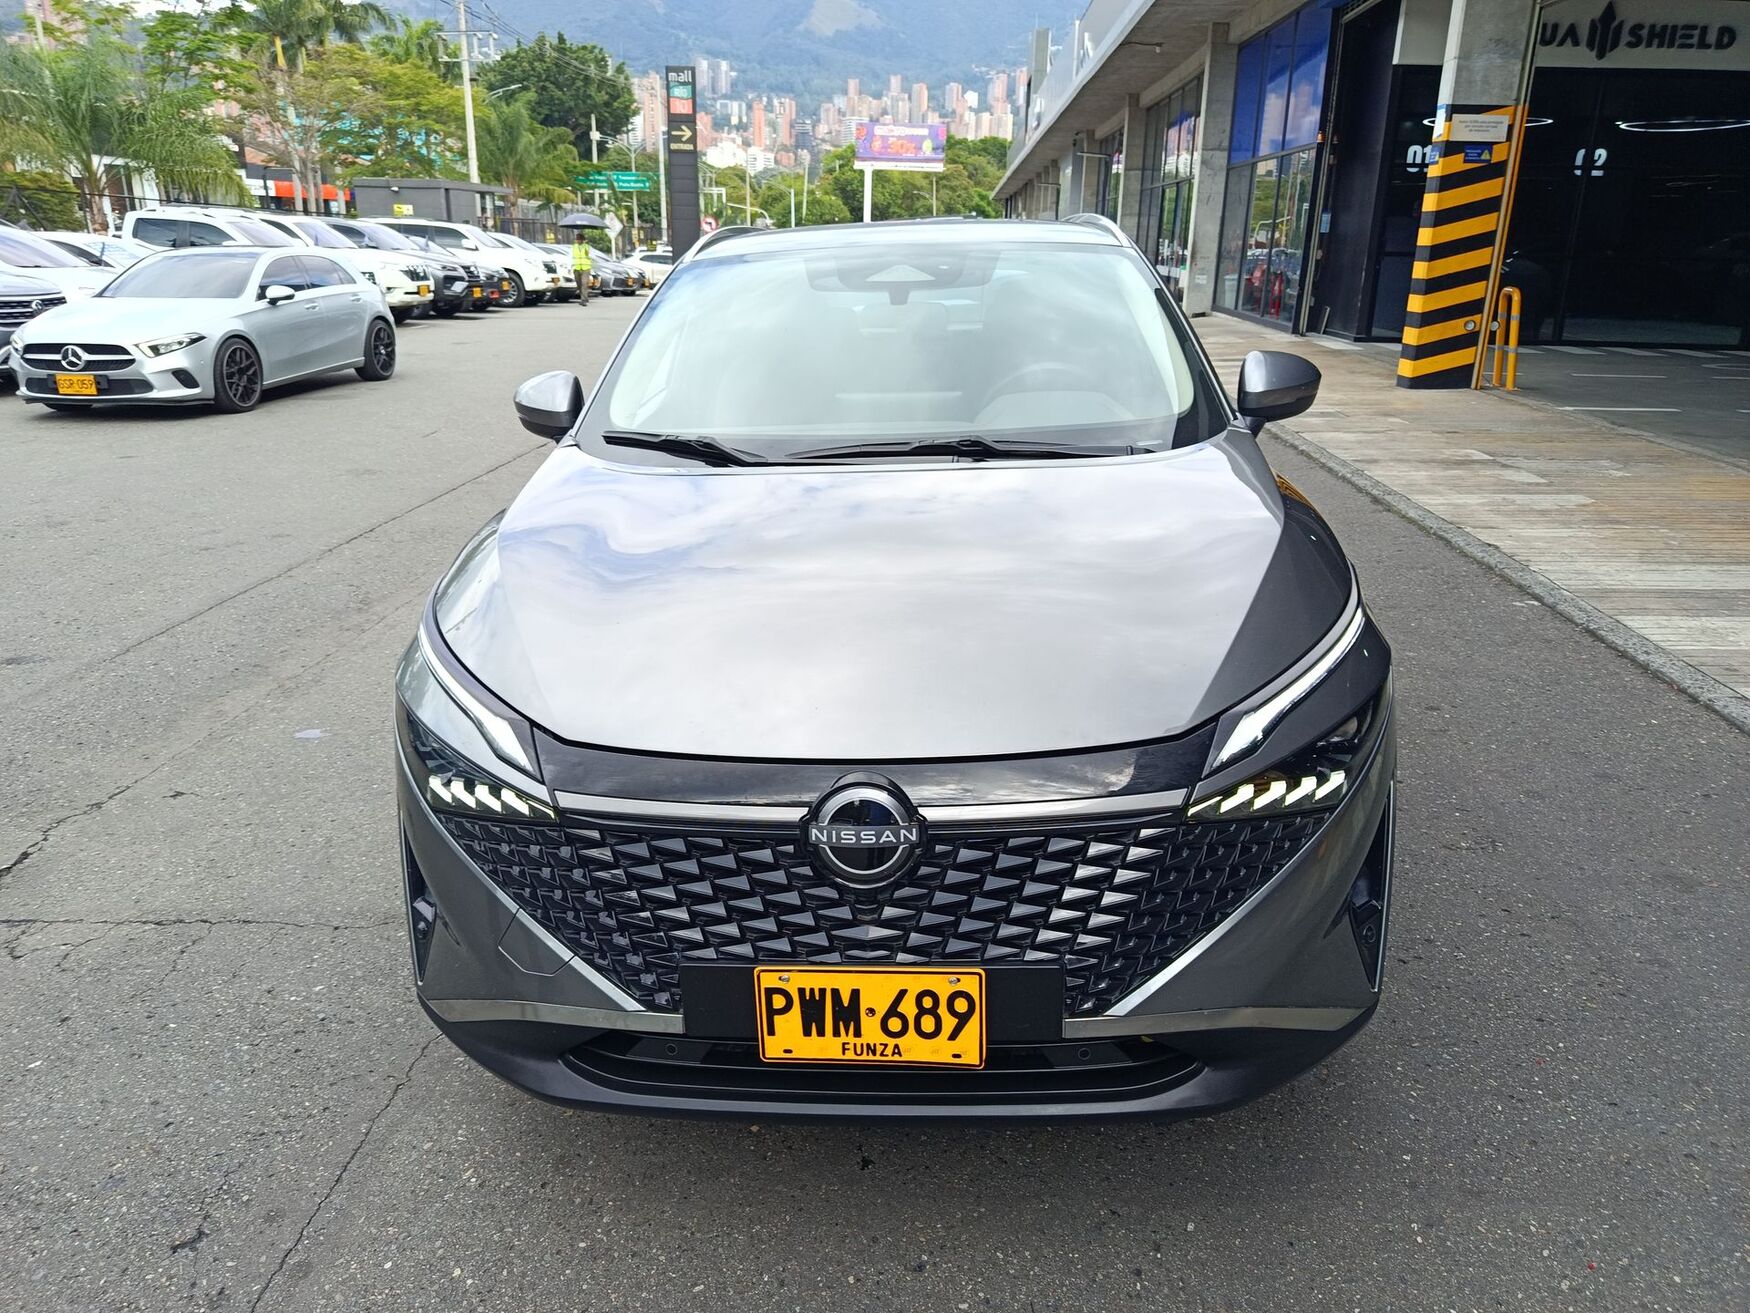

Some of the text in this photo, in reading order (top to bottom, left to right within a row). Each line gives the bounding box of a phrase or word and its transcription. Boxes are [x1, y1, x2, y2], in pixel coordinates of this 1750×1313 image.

[1624, 23, 1737, 50] SHIELD
[668, 70, 692, 82] mall
[1406, 144, 1433, 172] 01
[811, 828, 917, 844] NISSAN
[841, 1042, 903, 1057] FUNZA
